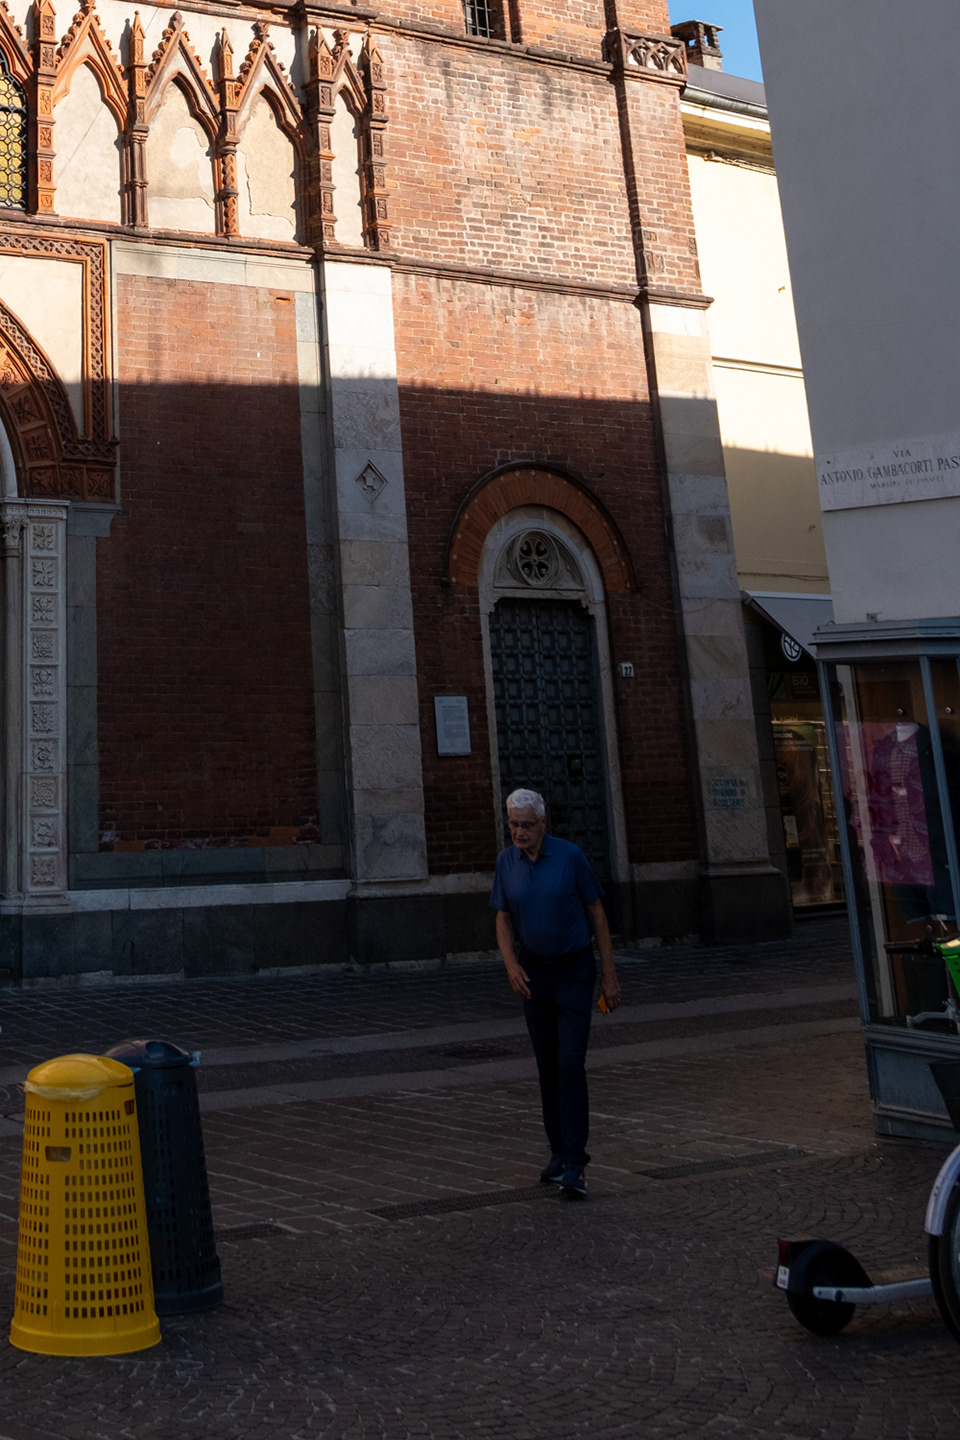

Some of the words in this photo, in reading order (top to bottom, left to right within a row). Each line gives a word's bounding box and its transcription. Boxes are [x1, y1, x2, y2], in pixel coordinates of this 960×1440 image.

[893, 449, 911, 458] VIA
[820, 468, 864, 486] ANTONIO
[868, 459, 933, 480] GAMBACORTI
[937, 456, 960, 471] PAS
